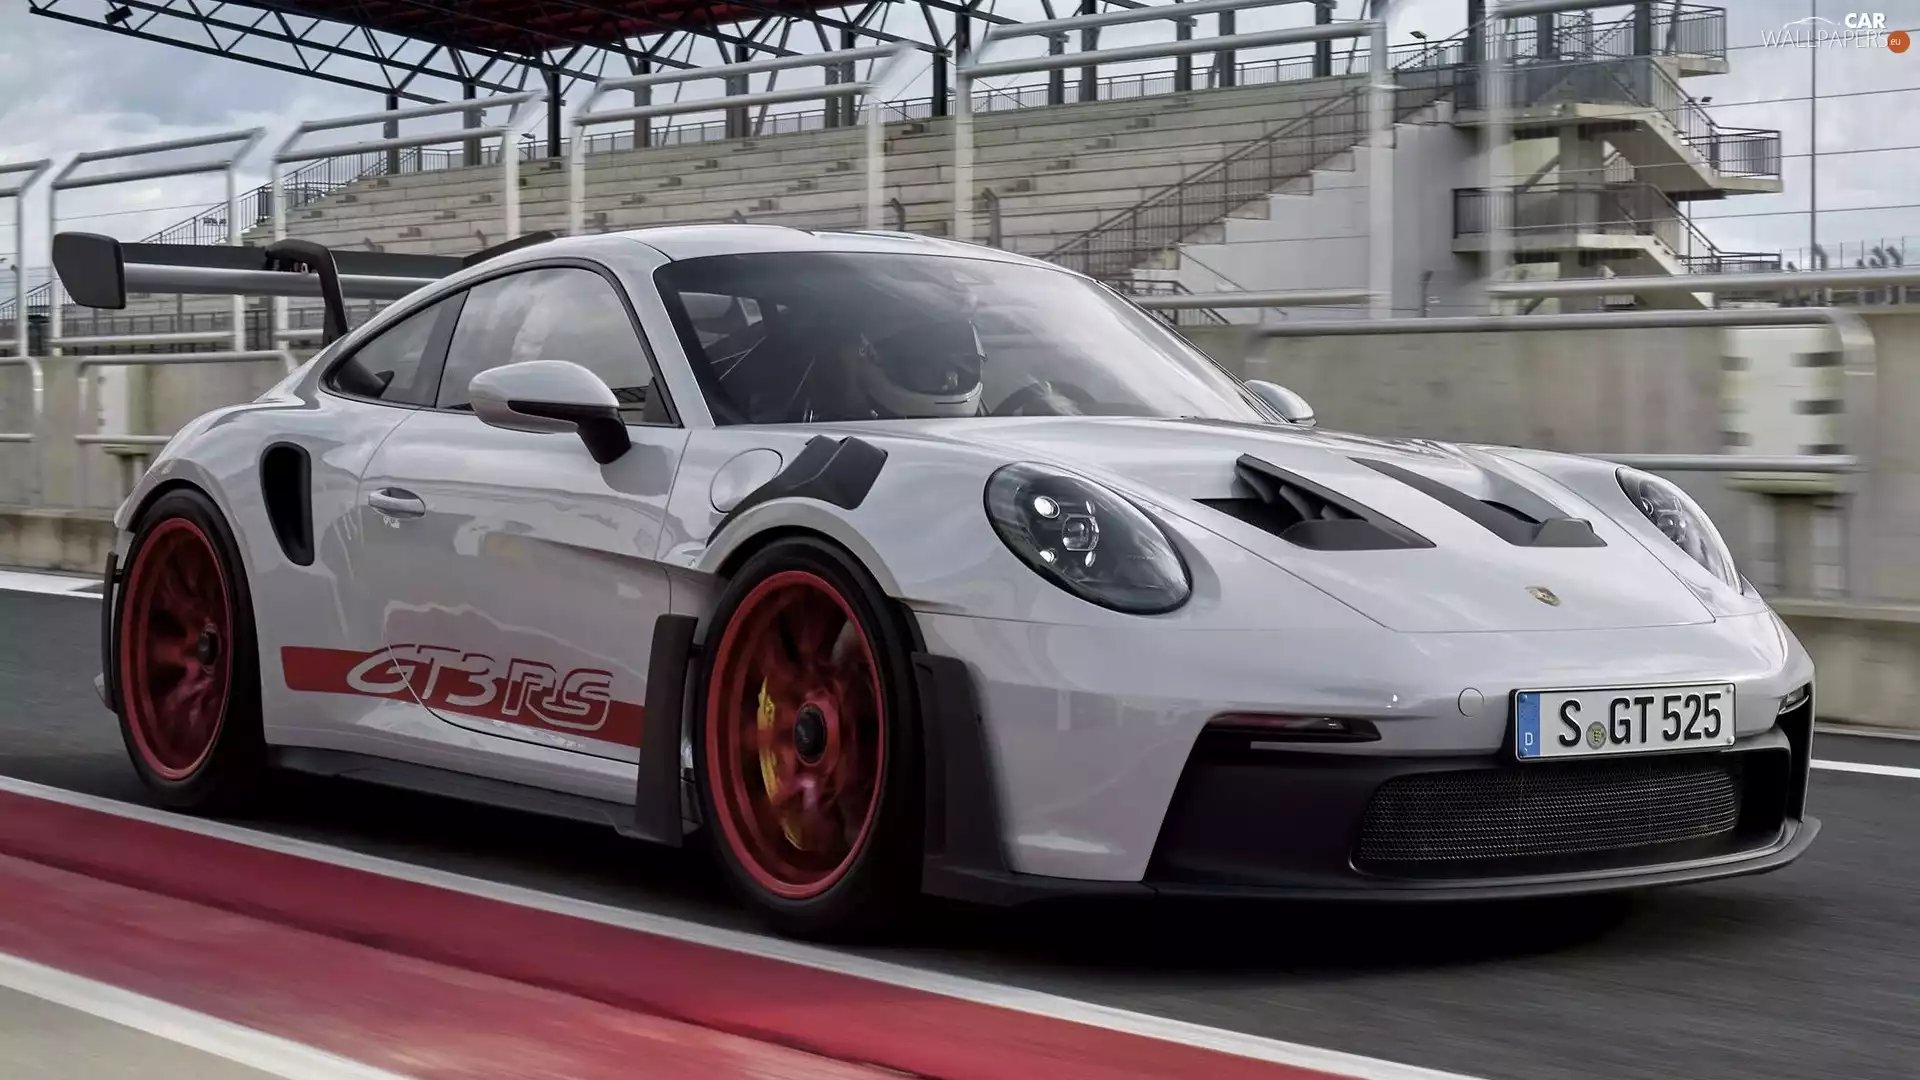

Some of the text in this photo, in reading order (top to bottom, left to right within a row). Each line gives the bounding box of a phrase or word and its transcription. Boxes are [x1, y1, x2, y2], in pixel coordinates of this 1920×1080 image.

[346, 643, 614, 731] GT3 RS
[1524, 731, 1533, 746] D
[1558, 693, 1722, 747] S GT 525
